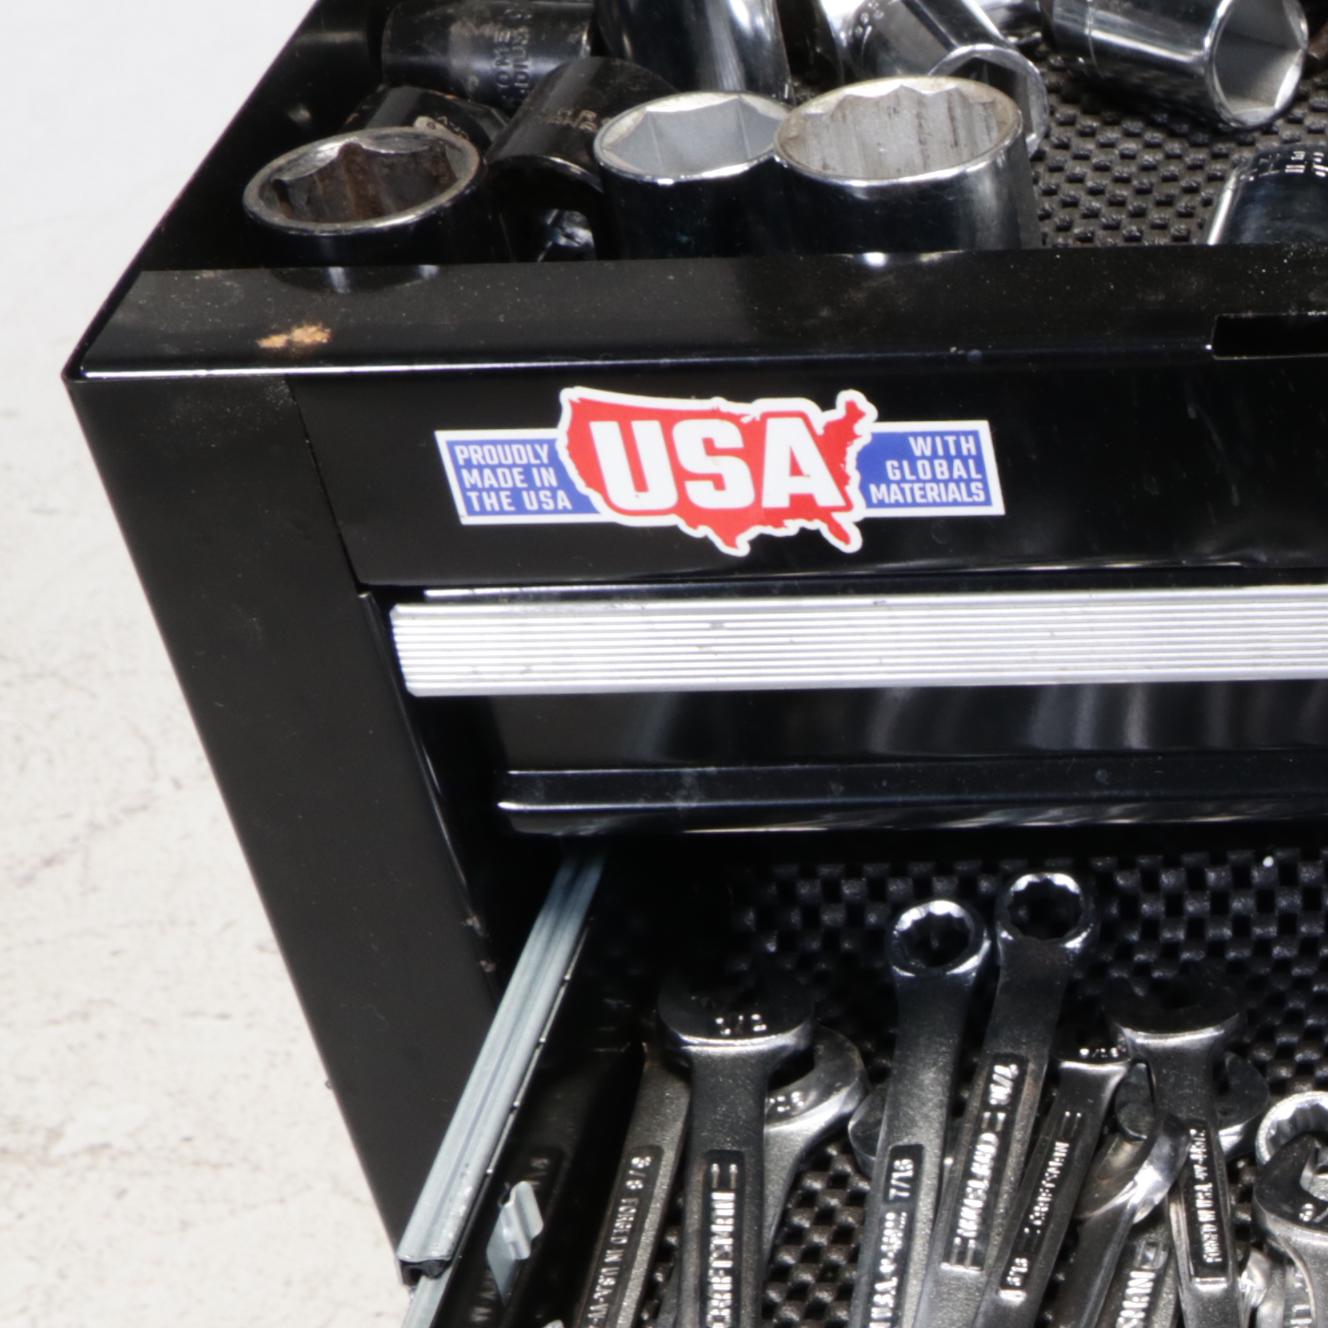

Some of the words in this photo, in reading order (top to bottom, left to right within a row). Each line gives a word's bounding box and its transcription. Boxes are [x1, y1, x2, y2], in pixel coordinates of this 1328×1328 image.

[455, 443, 551, 467] PROUDLY
[908, 434, 979, 458] WITH
[588, 415, 847, 512] USA
[884, 457, 984, 482] GLOBAL
[462, 466, 528, 489] MADE
[532, 465, 558, 487] IN
[466, 490, 518, 512] THE
[521, 488, 573, 511] USA
[870, 480, 987, 506] MATERIALS
